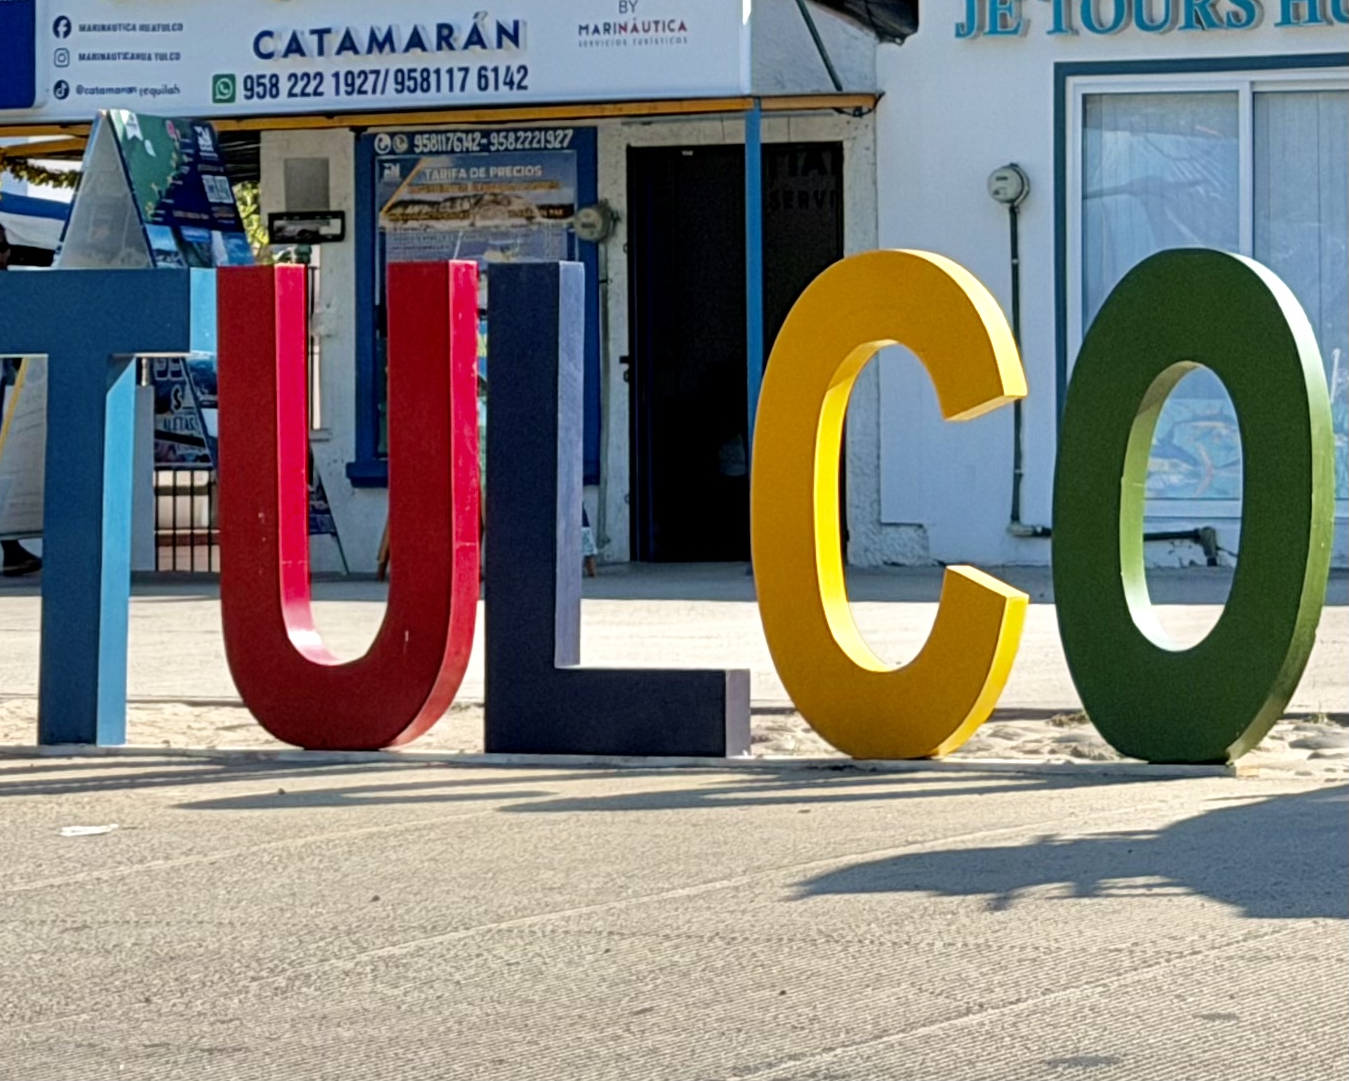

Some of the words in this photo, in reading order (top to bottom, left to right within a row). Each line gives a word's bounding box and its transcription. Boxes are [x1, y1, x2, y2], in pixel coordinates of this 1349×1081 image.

[618, 0, 638, 14] BY
[252, 10, 523, 60] CATAMARÁN
[243, 73, 280, 100] 958
[287, 71, 324, 98] 222
[477, 64, 529, 92] 6142
[425, 167, 467, 180] TARIFA
[470, 167, 485, 179] DE
[489, 165, 543, 178] PRECIOS
